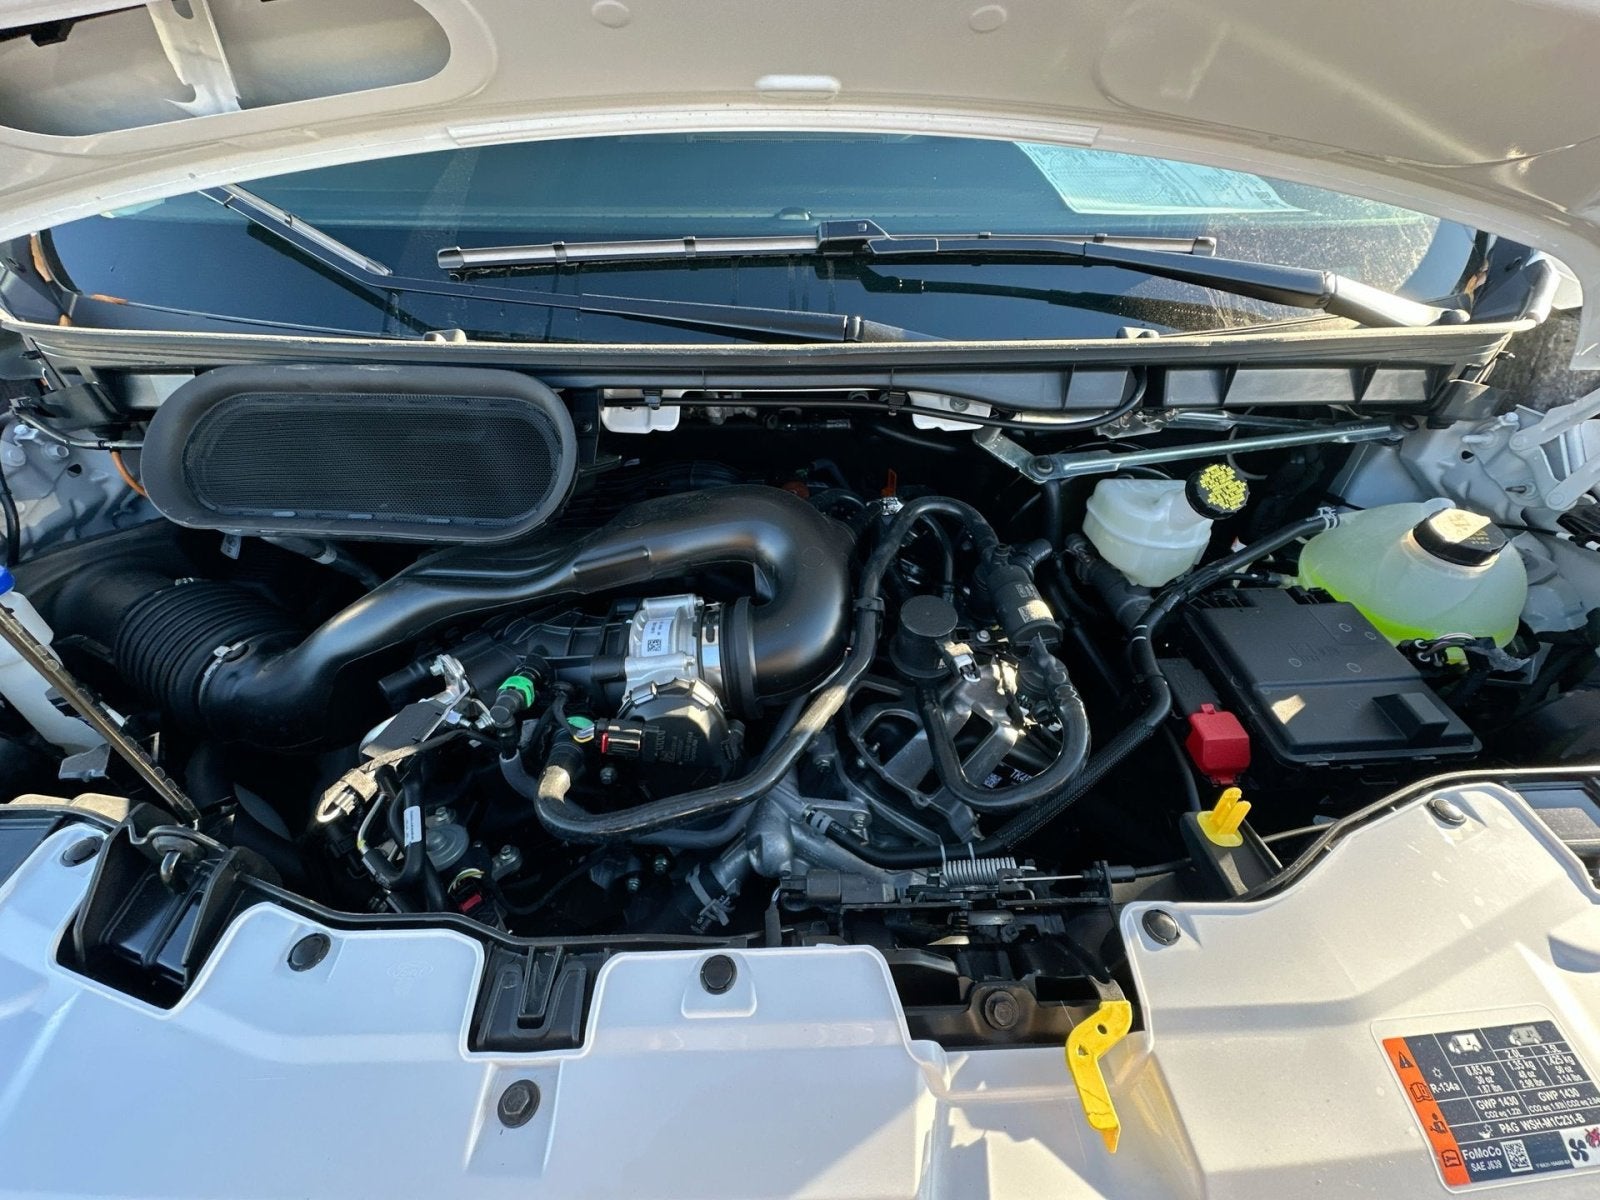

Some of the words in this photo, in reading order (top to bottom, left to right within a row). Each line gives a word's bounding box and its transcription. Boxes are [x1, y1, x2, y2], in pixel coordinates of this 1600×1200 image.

[1505, 1048, 1524, 1059] 2.0L
[1542, 1044, 1561, 1054] 3.5L
[1507, 1060, 1525, 1070] 1.35
[1522, 1059, 1537, 1071] kg
[1542, 1054, 1564, 1066] 1.425
[1560, 1054, 1576, 1066] kg
[1480, 1064, 1495, 1076] kg
[1527, 1070, 1537, 1078] oz
[1430, 1081, 1461, 1094] R-134a
[1537, 1090, 1558, 1102] GWP
[1559, 1087, 1580, 1098] 1430
[1476, 1098, 1497, 1110] GWP
[1498, 1095, 1520, 1107] 1430
[1528, 1104, 1543, 1113] CO2
[1566, 1099, 1581, 1108] CO2
[1484, 1110, 1499, 1119] CO2
[1498, 1122, 1520, 1134] PAG
[1520, 1113, 1586, 1131] WSH-M1C231-B
[1461, 1145, 1502, 1160] FoMoCo
[1470, 1162, 1487, 1172] SAE
[1487, 1160, 1503, 1170] J639
